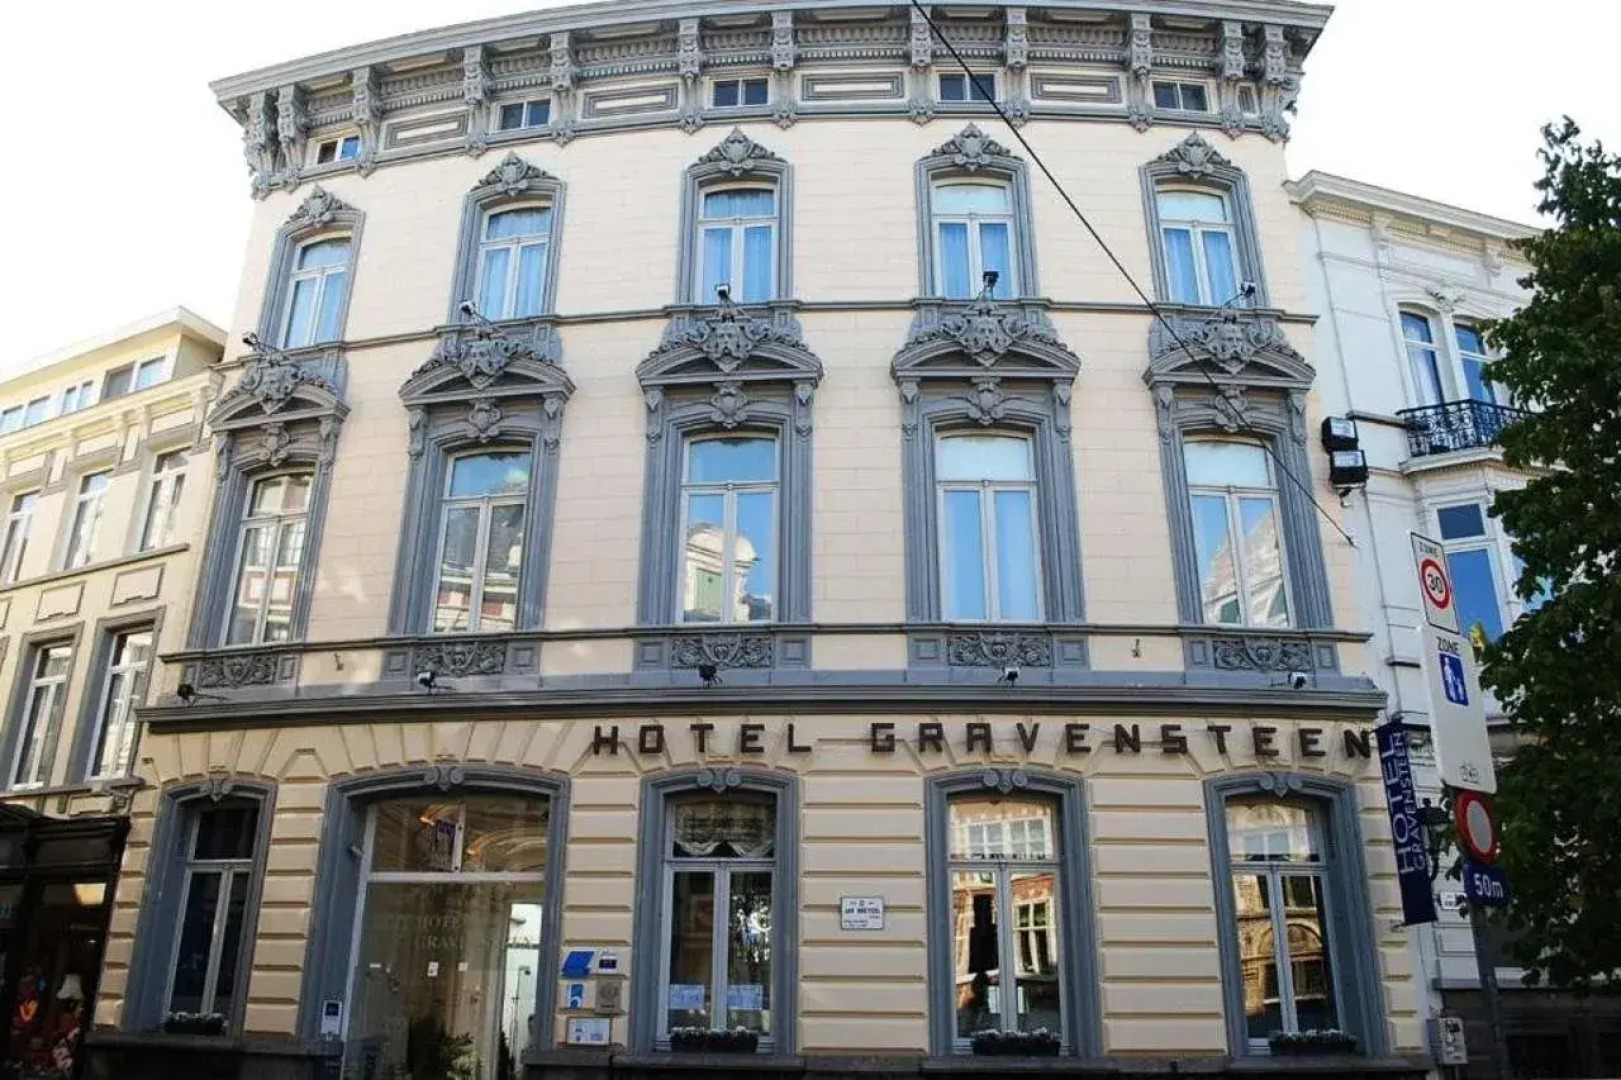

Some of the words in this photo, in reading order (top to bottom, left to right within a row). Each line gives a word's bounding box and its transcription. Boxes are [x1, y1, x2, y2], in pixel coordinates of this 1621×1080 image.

[1427, 573, 1444, 593] 30
[1436, 636, 1459, 656] ZONE
[593, 723, 812, 755] HOTEL
[871, 722, 1371, 758] GRAVENSTEEN
[1382, 734, 1415, 874] HOTEL
[1392, 732, 1426, 871] GRAVENSTEEN
[1473, 872, 1503, 898] 50m
